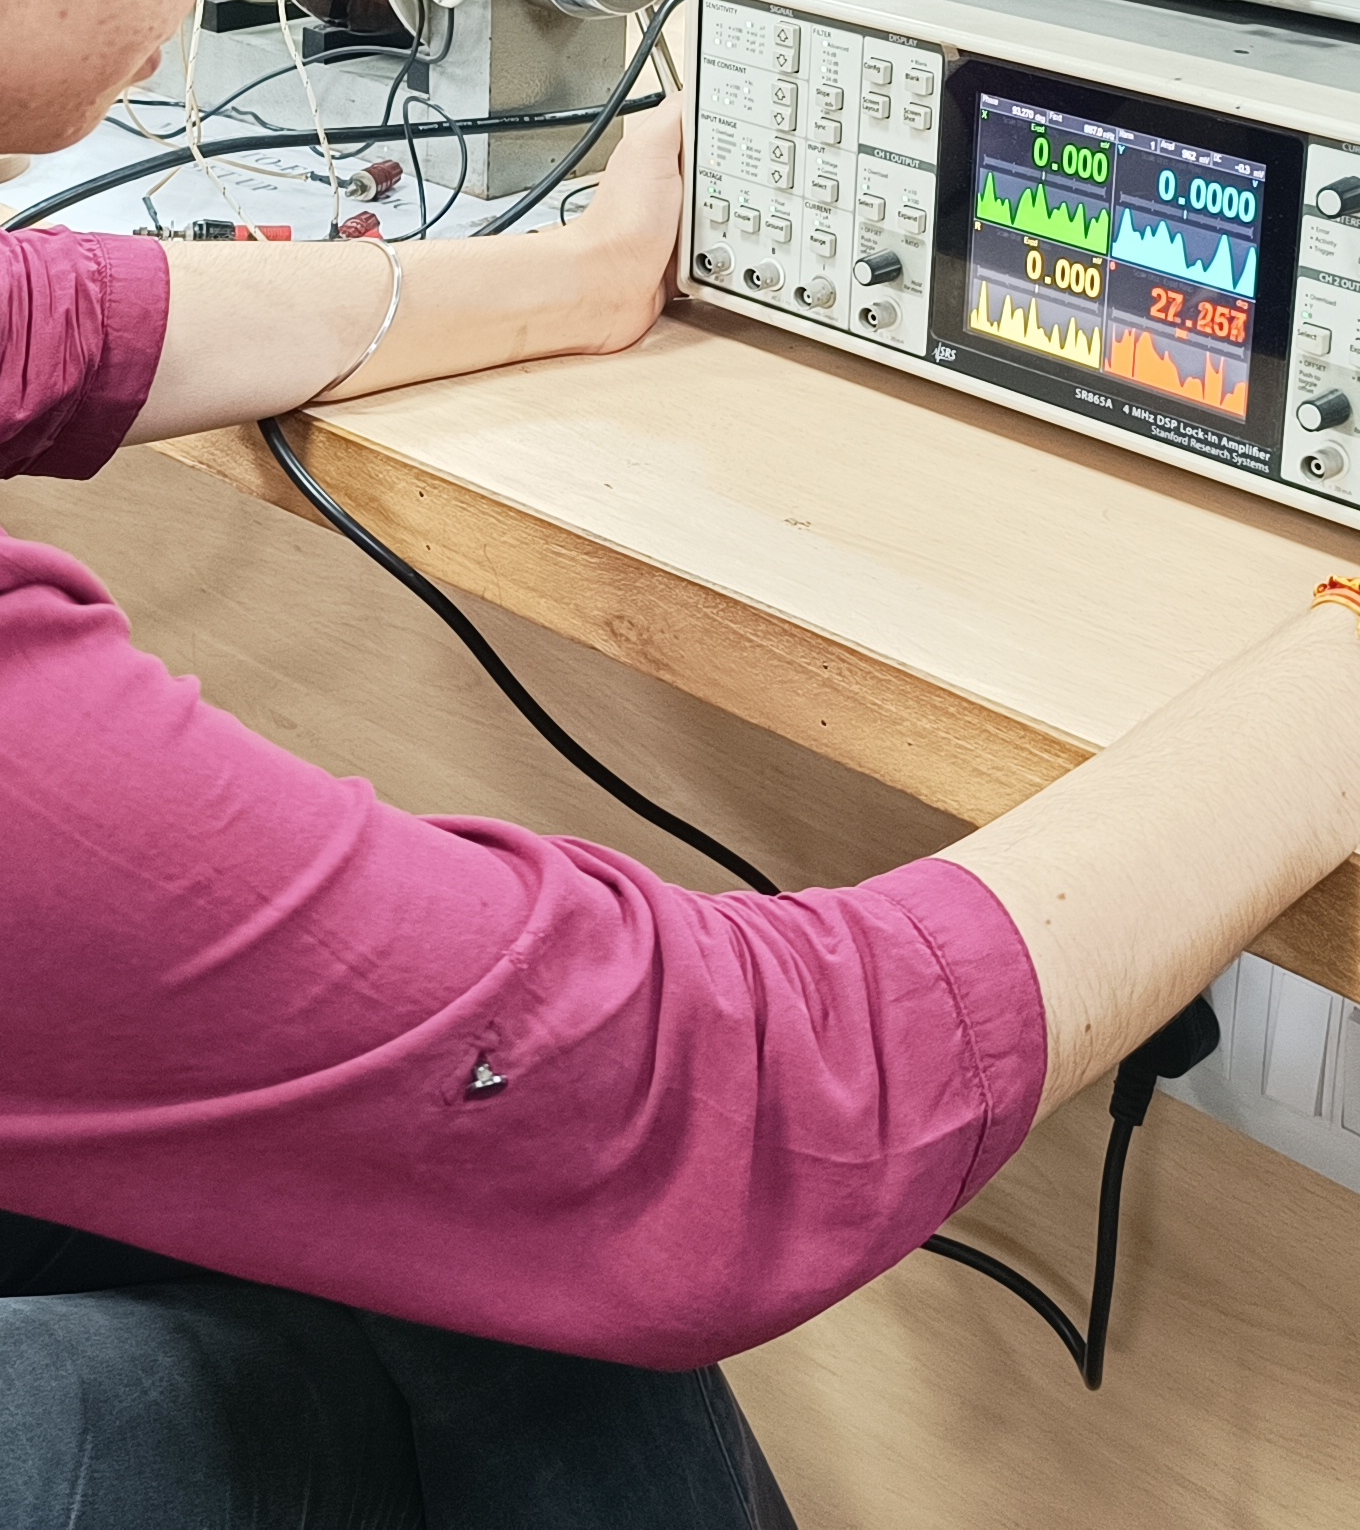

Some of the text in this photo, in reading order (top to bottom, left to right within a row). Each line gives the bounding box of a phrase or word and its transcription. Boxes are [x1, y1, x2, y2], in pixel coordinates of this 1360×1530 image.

[706, 2, 737, 14] SENSITIVITY
[770, 5, 793, 17] SIGNAL
[813, 28, 831, 38] FILTER
[889, 34, 918, 46] DISPLAY
[828, 42, 849, 52] Advanced
[704, 57, 746, 74] TIME CONSTANT
[864, 62, 880, 73] Config
[905, 73, 919, 81] Blank
[816, 88, 830, 97] Slope
[863, 97, 879, 106] Screen
[982, 95, 998, 105] Phase
[863, 104, 879, 113] Layout
[904, 108, 921, 117] Screen
[904, 114, 915, 122] Shot
[982, 110, 987, 119] X
[701, 113, 737, 129] INPUT RANGE
[815, 122, 826, 130] Sync
[808, 144, 825, 153] INPUT
[1118, 145, 1125, 154] Y
[874, 150, 919, 168] CH OUTPUT
[1032, 136, 1109, 184] 0.000
[1213, 154, 1222, 163] DC
[699, 169, 722, 181] VOLTAGE
[812, 180, 827, 190] Select
[1157, 169, 1257, 223] 0.0000
[805, 201, 831, 215] CURRENT
[859, 199, 873, 208] Select
[734, 212, 750, 221] Couple
[898, 211, 917, 222] Expand
[765, 221, 783, 231] Ground
[974, 221, 981, 231] R
[1316, 226, 1330, 235] Error
[865, 227, 882, 236] OFFSET
[810, 235, 826, 245] Range
[1314, 235, 1337, 249] Activity
[1314, 245, 1335, 258] Trigger
[1025, 250, 1101, 298] 0.000
[1319, 273, 1333, 284] CH
[1310, 292, 1336, 308] Overload
[1297, 328, 1317, 342] Select
[940, 346, 957, 361] SRS
[1304, 359, 1327, 372] OFFSET
[1299, 370, 1311, 380] Push
[1298, 377, 1318, 389] toggle
[1075, 388, 1271, 462] SR865A 4 MHz DSP Lock-In Amplifier
[1151, 425, 1269, 473] Stanford Research Systems
